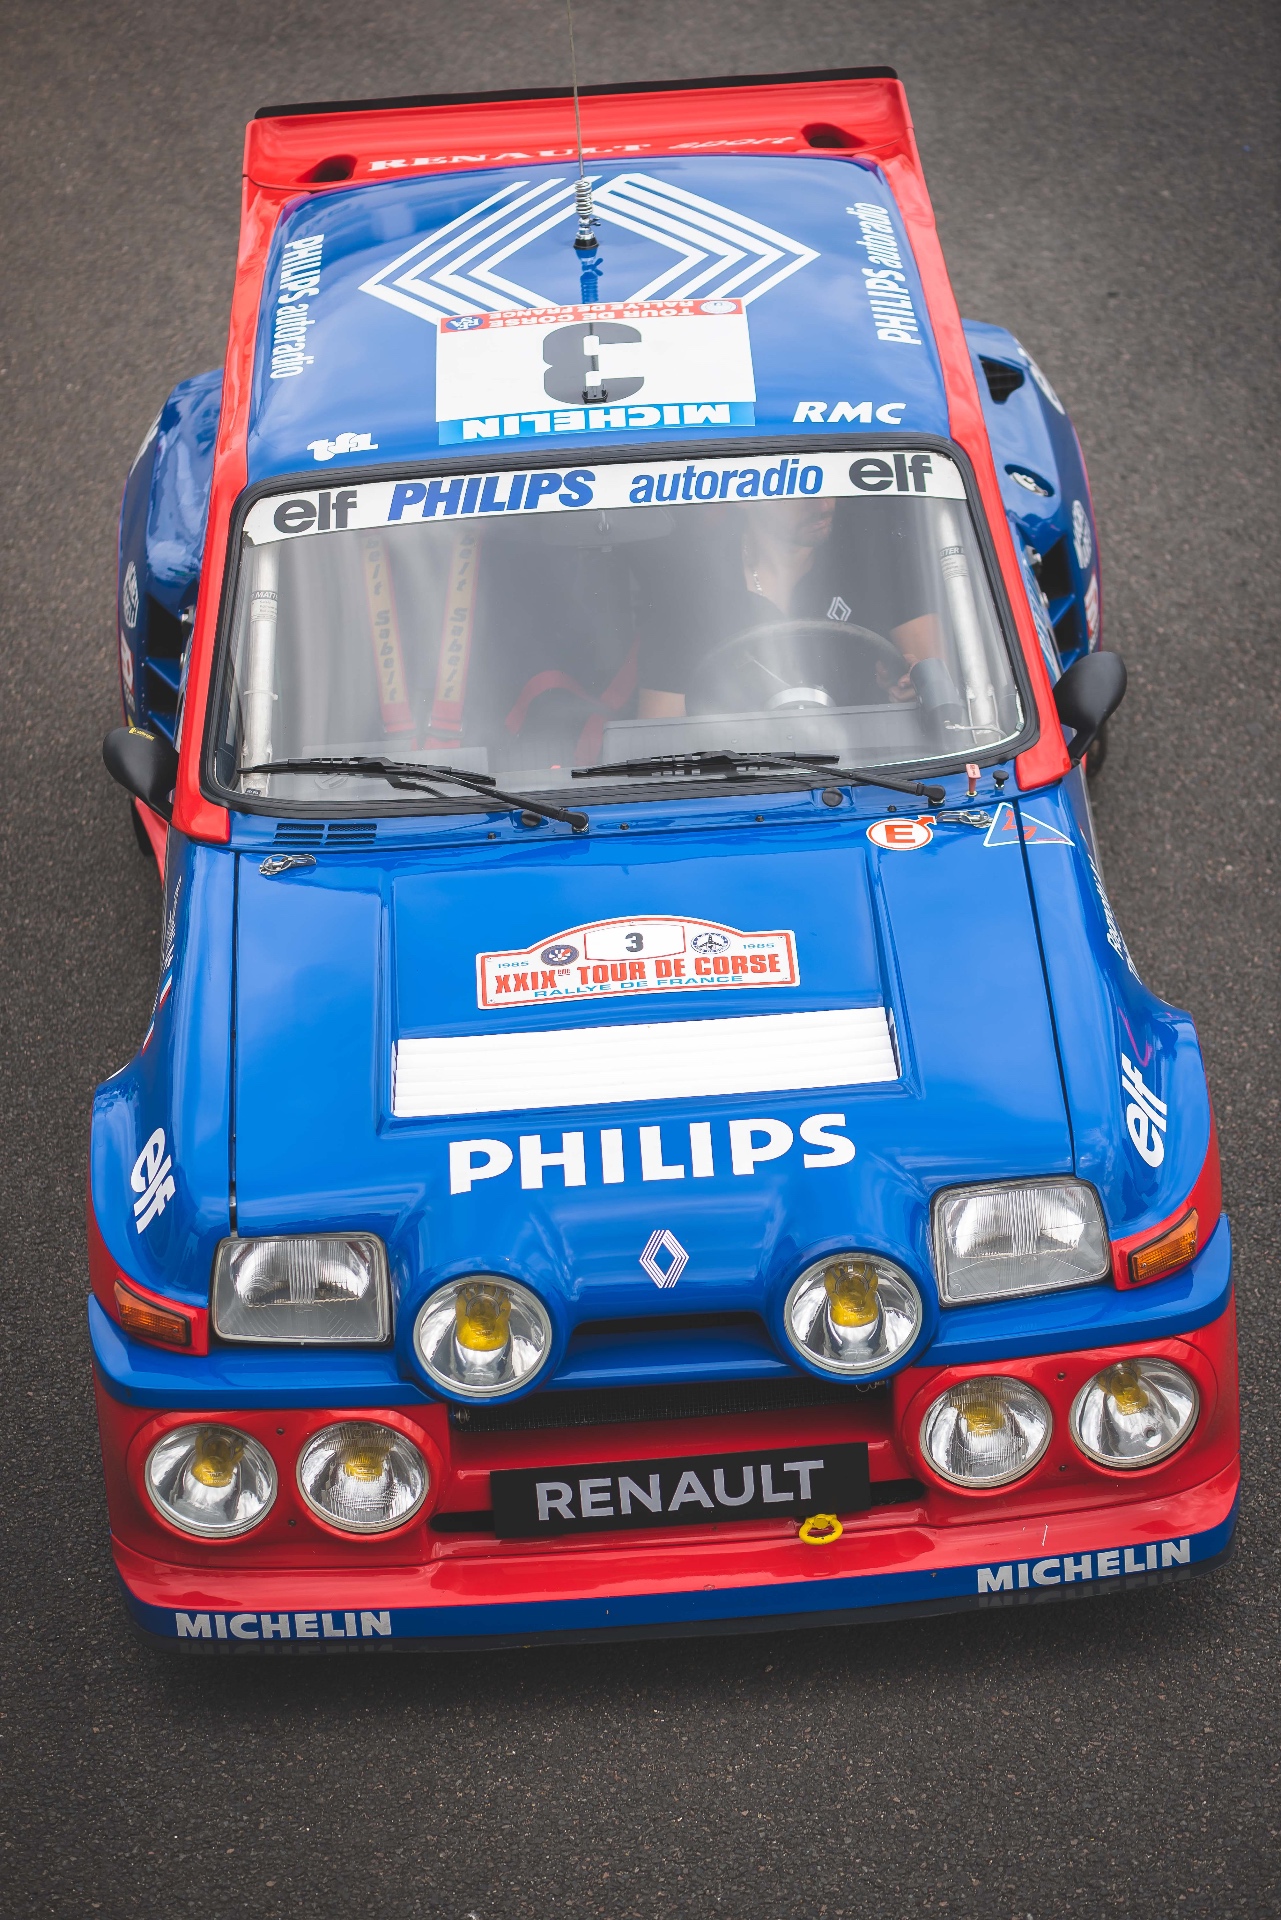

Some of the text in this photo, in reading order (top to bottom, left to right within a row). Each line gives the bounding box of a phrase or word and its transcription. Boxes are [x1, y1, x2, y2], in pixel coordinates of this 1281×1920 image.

[368, 144, 651, 171] RENAULT
[845, 202, 922, 345] PHILIPS autoradio
[269, 233, 325, 379] PHILIPS autoradio
[489, 308, 695, 328] TOUR DE CORSE
[490, 306, 574, 319] FRANCE
[579, 303, 606, 314] DE
[611, 300, 693, 311] RALLYE
[542, 321, 645, 406] 3
[462, 403, 731, 440] MICHELIN
[792, 401, 907, 425] RMC
[273, 453, 933, 533] elf PHILIPS autoradio elf
[374, 608, 397, 701] Sabelt
[444, 607, 468, 699] Sabelt
[884, 824, 916, 843] E
[624, 932, 645, 953] 3
[742, 942, 775, 950] 1985
[498, 960, 530, 969] 1985
[576, 961, 646, 985] TOUR
[656, 958, 687, 978] DE
[695, 953, 781, 976] CORSE
[534, 975, 743, 998] RALLYE DE FRANCE
[1122, 1052, 1168, 1168] elf
[449, 1112, 857, 1196] PHILIPS
[130, 1127, 176, 1235] elf
[535, 1459, 824, 1521] RENAULT
[977, 1538, 1191, 1594] MICHELIN
[175, 1610, 392, 1640] MICHELIN
